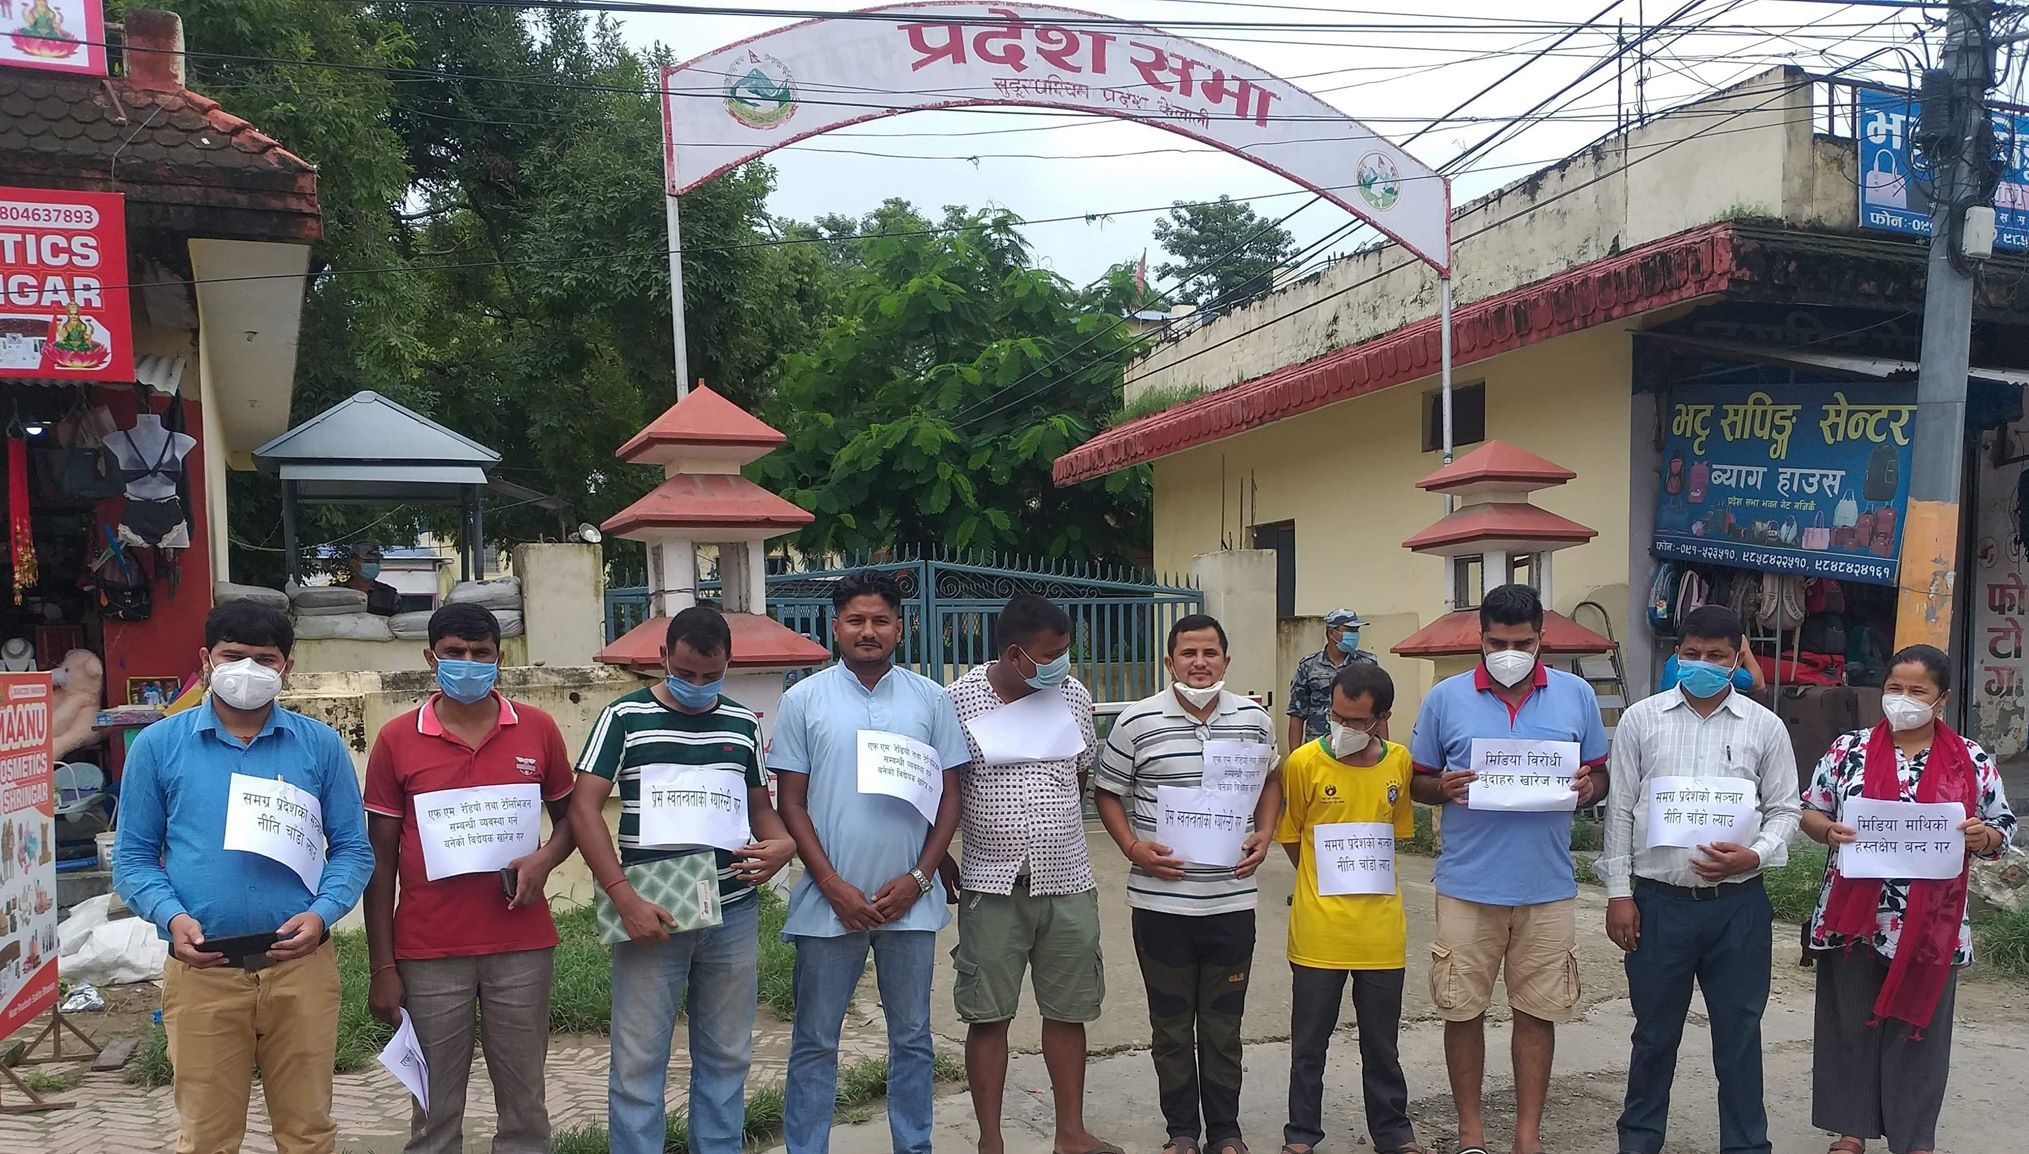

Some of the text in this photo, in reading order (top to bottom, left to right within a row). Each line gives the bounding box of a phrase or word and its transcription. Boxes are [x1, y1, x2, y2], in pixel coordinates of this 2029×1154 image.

[897, 8, 1281, 128] प्रदेश सभा
[0, 206, 93, 224] 804637893
[0, 233, 99, 267] TICS
[0, 274, 101, 307] GAR
[1819, 391, 1917, 445] सेन्टर
[1711, 464, 1845, 497] ब्याग हाउस
[1485, 751, 1562, 767] मिडिया विरोधी
[1520, 772, 1551, 787] खारेज
[1556, 776, 1572, 788] गर
[651, 785, 663, 808] प्रेस
[1656, 791, 1675, 803] समग्र
[1680, 788, 1710, 803] प्रदेशको
[243, 793, 271, 808] समग्र
[277, 796, 308, 822] प्रदेशको
[428, 809, 441, 821] एफ
[443, 807, 455, 819] एम
[460, 800, 481, 815] रेडियो
[257, 814, 281, 834] नीति
[1664, 808, 1682, 824] नीति
[1713, 813, 1735, 827] ल्याउ
[1858, 815, 1949, 831] मिडिया माथिको
[1324, 838, 1344, 851] समग्र
[1348, 833, 1375, 850] प्रदेशको
[1855, 838, 1951, 854] हस्तक्षेप बन्द गर
[1337, 856, 1355, 872] नीति
